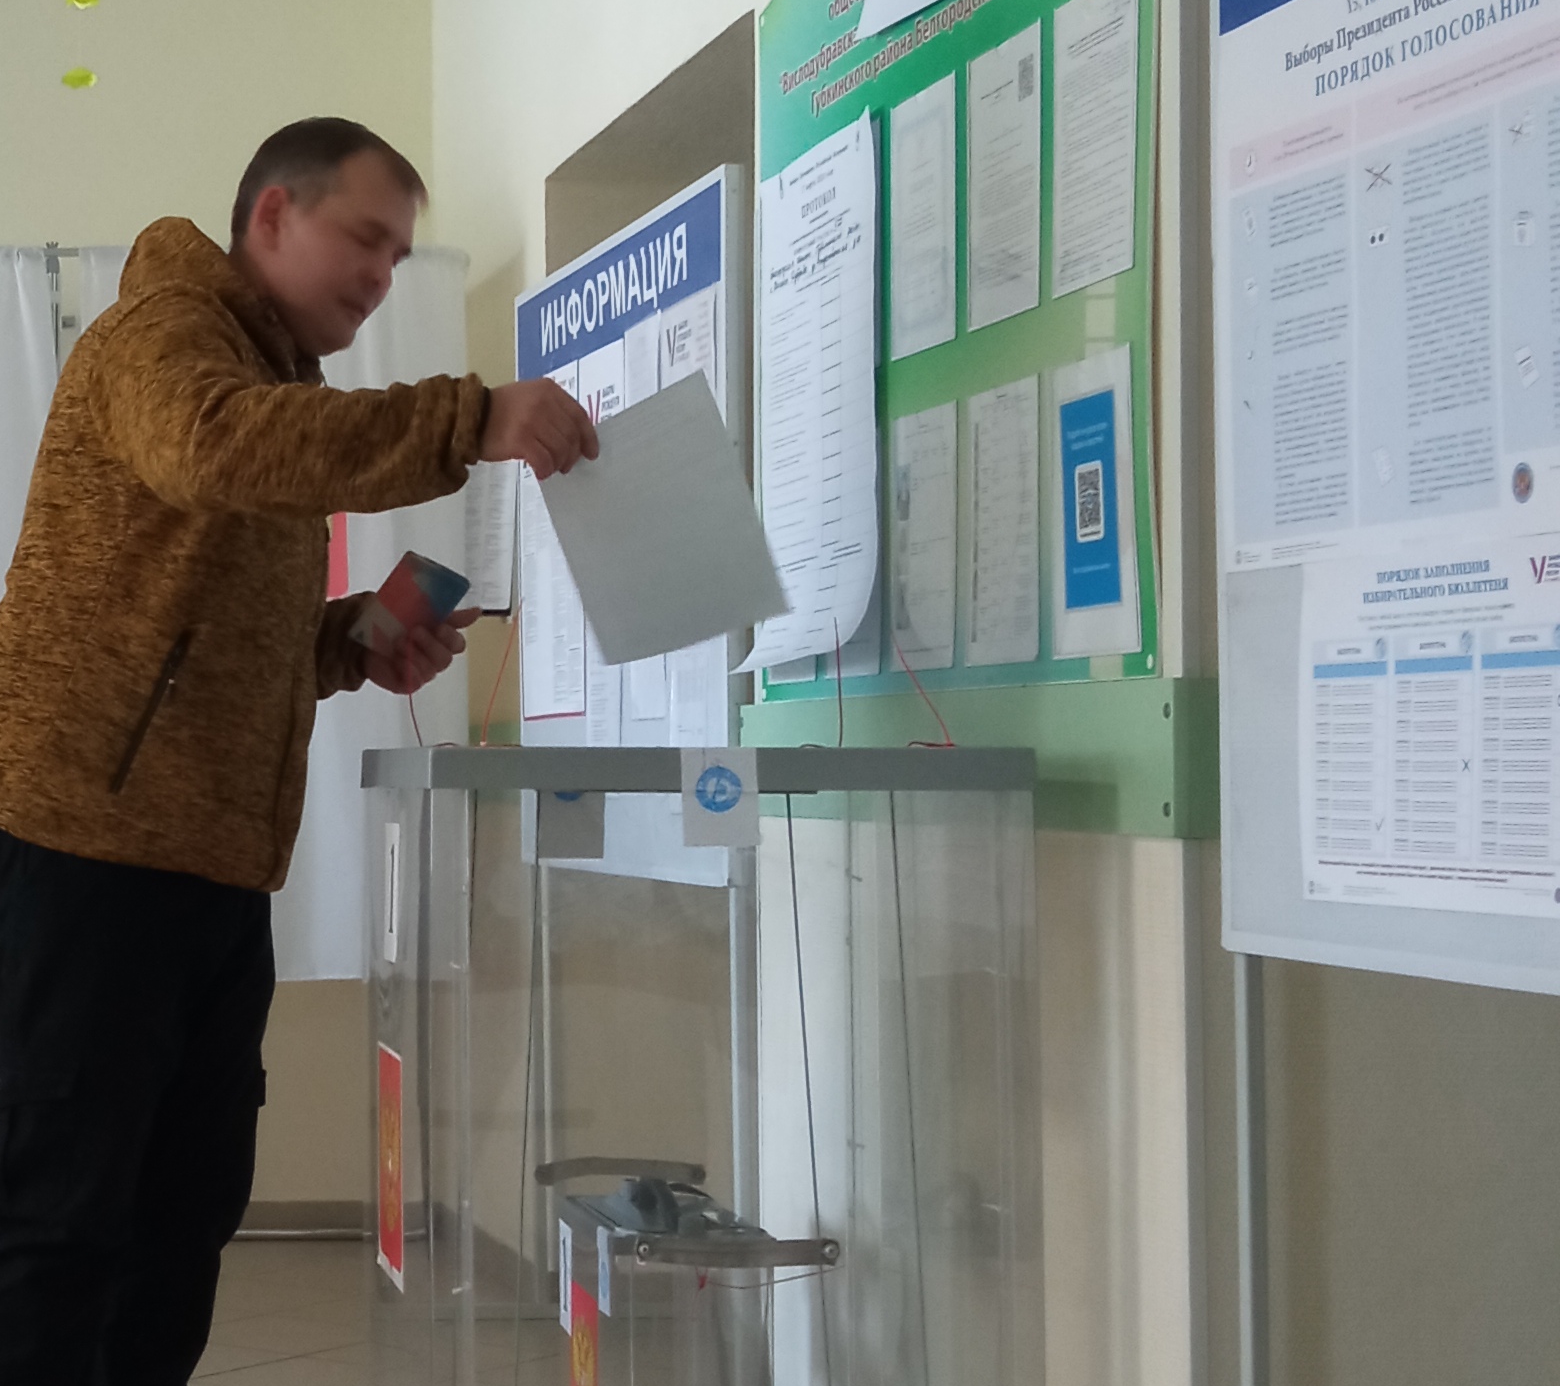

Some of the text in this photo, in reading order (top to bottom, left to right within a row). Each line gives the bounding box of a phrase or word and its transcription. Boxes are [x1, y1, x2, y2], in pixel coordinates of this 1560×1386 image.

[1285, 39, 1334, 71] Выборы
[1336, 4, 1410, 51] Президента
[1315, 47, 1396, 97] ПОРЯДОК
[810, 59, 872, 118] Губкинского
[873, 36, 914, 81] района
[541, 222, 687, 356] ИНФОРМАЦИЯ
